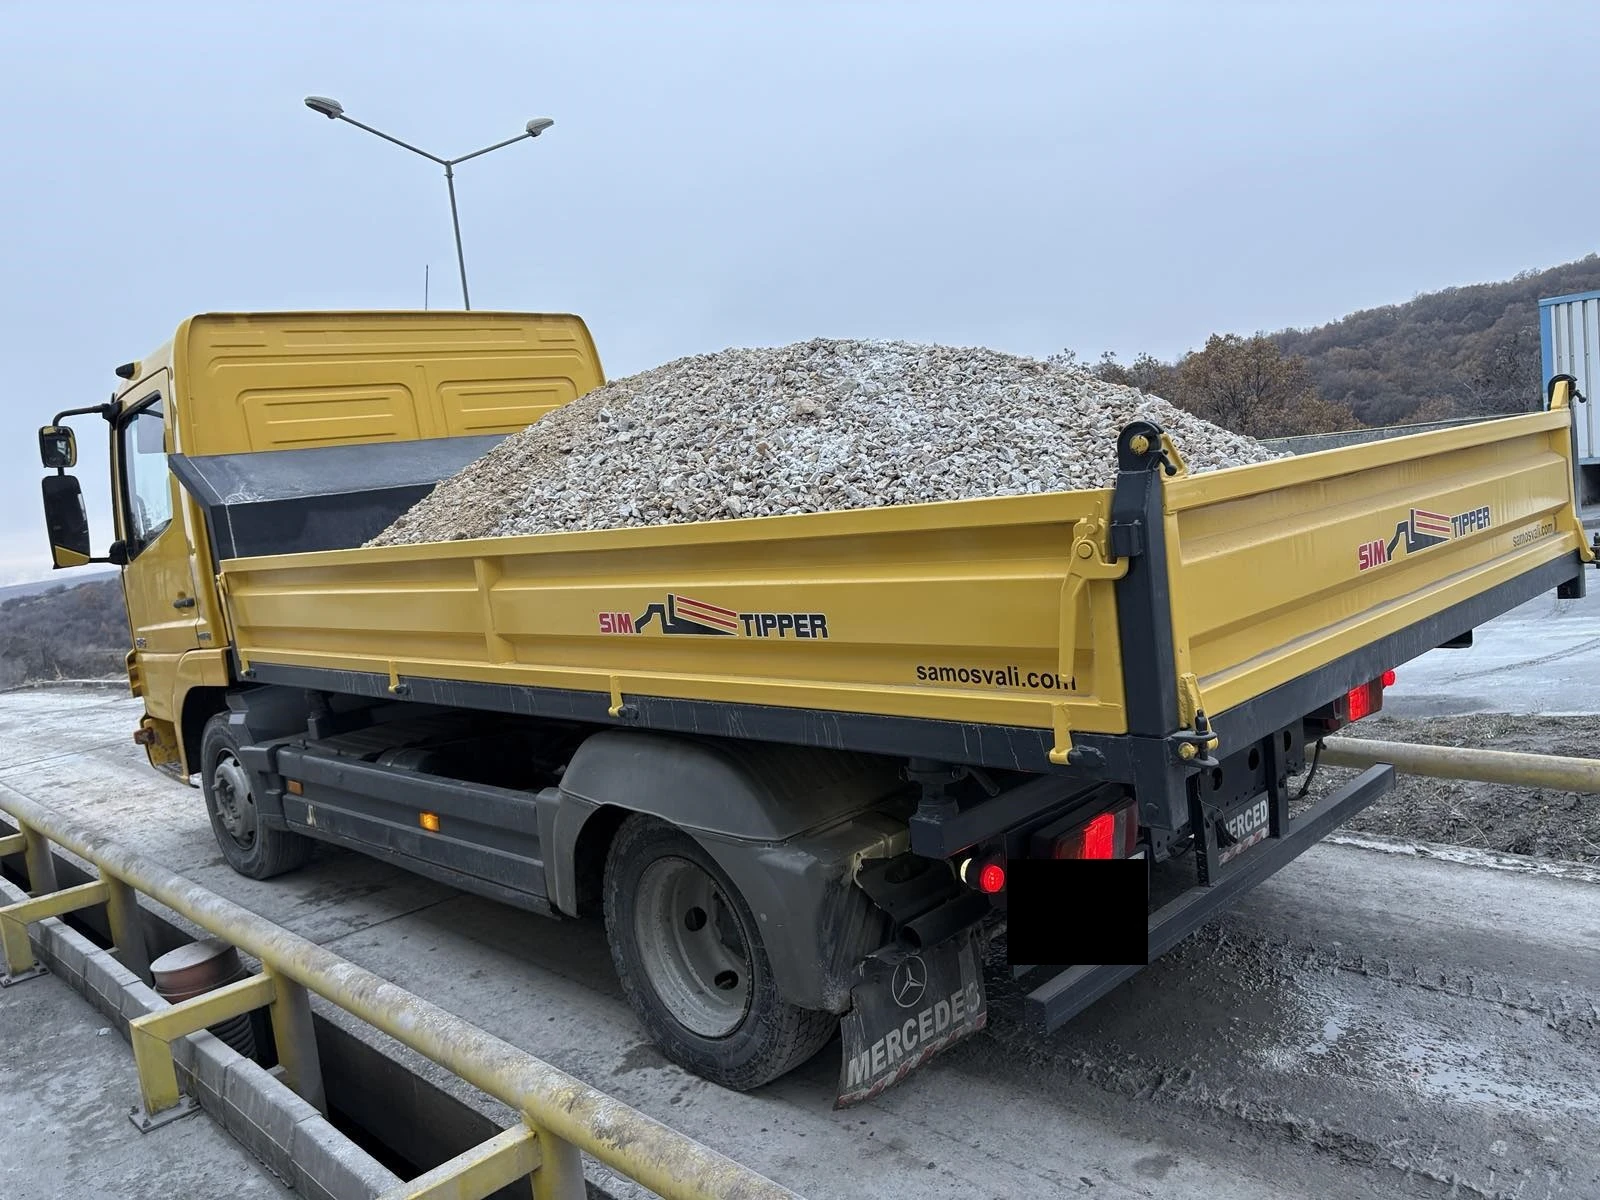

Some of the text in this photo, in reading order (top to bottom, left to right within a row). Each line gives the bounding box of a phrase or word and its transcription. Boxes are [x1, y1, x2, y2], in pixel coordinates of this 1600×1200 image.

[1358, 506, 1491, 571] SIM TIPPER
[599, 612, 828, 639] SIM TIPPER
[1225, 799, 1268, 839] ERCED
[847, 982, 981, 1088] MERCEDES
